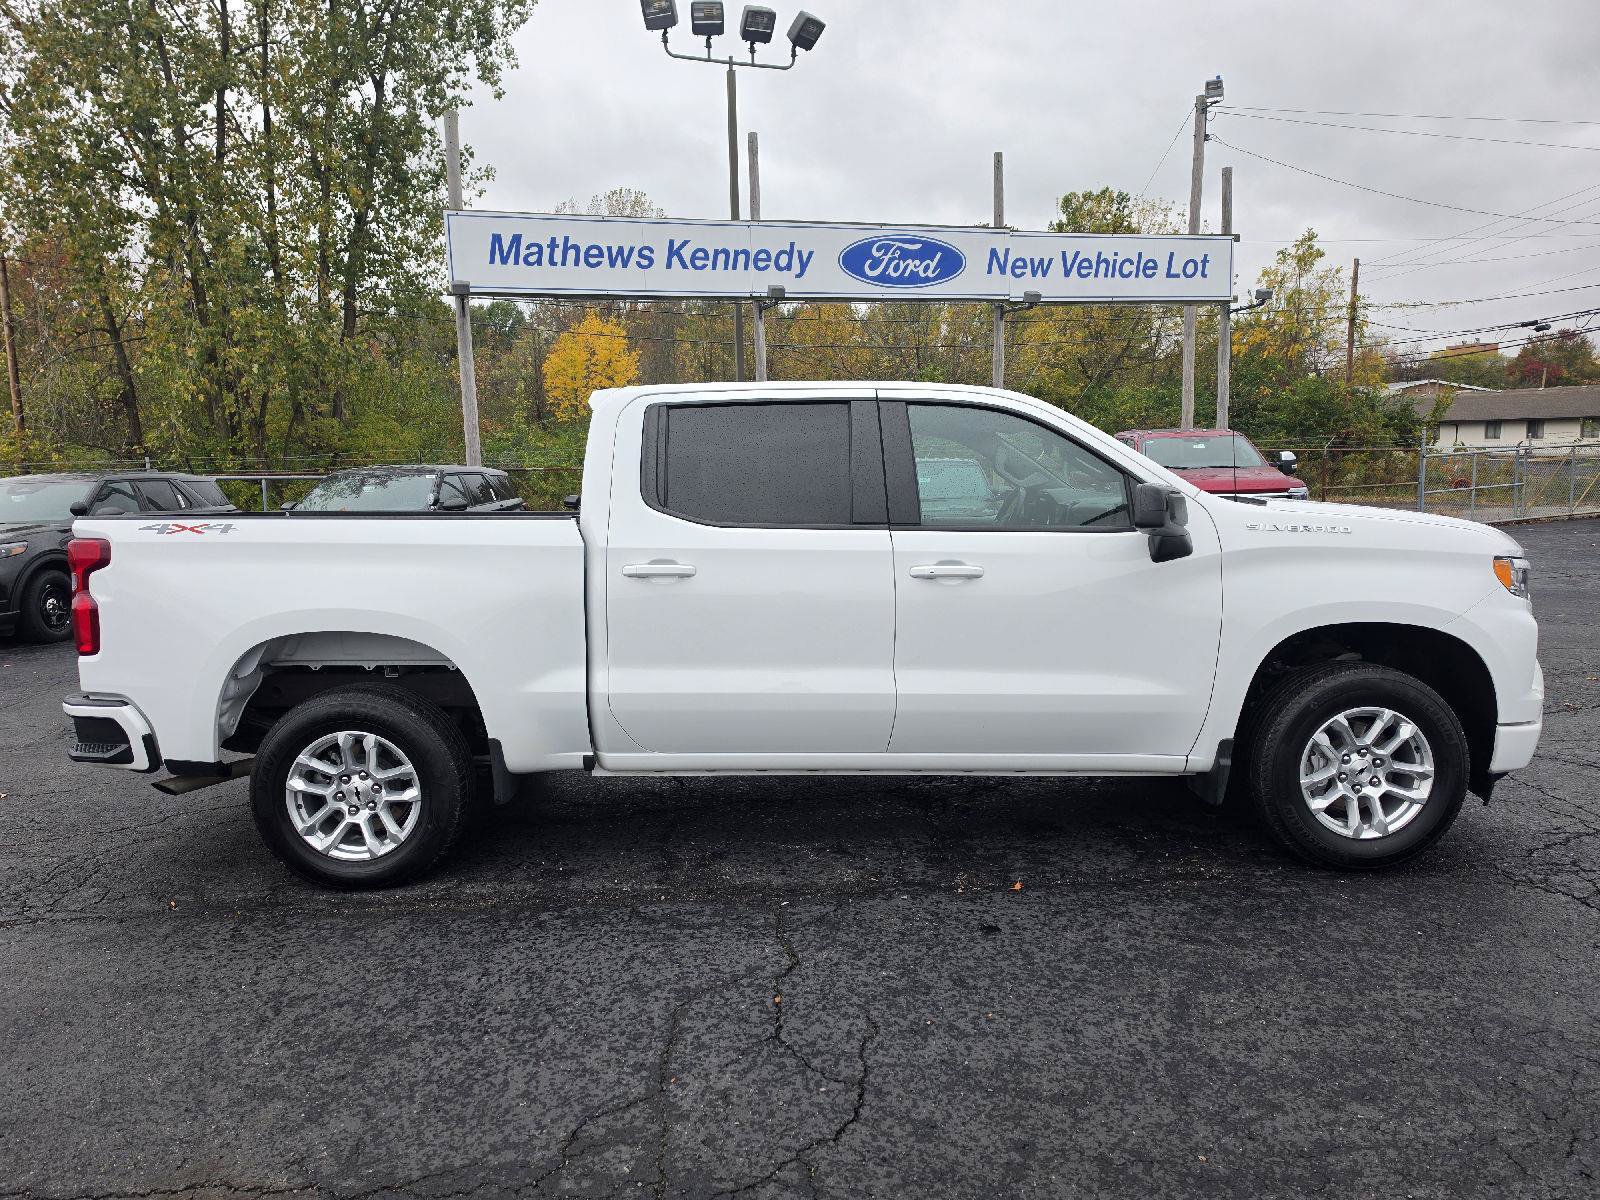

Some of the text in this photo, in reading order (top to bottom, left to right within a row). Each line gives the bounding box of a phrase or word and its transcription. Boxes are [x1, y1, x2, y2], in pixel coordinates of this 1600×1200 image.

[488, 233, 1210, 279] Mathews Kennedy Ford New Vehicle Lot
[1245, 521, 1353, 534] SILVERADO
